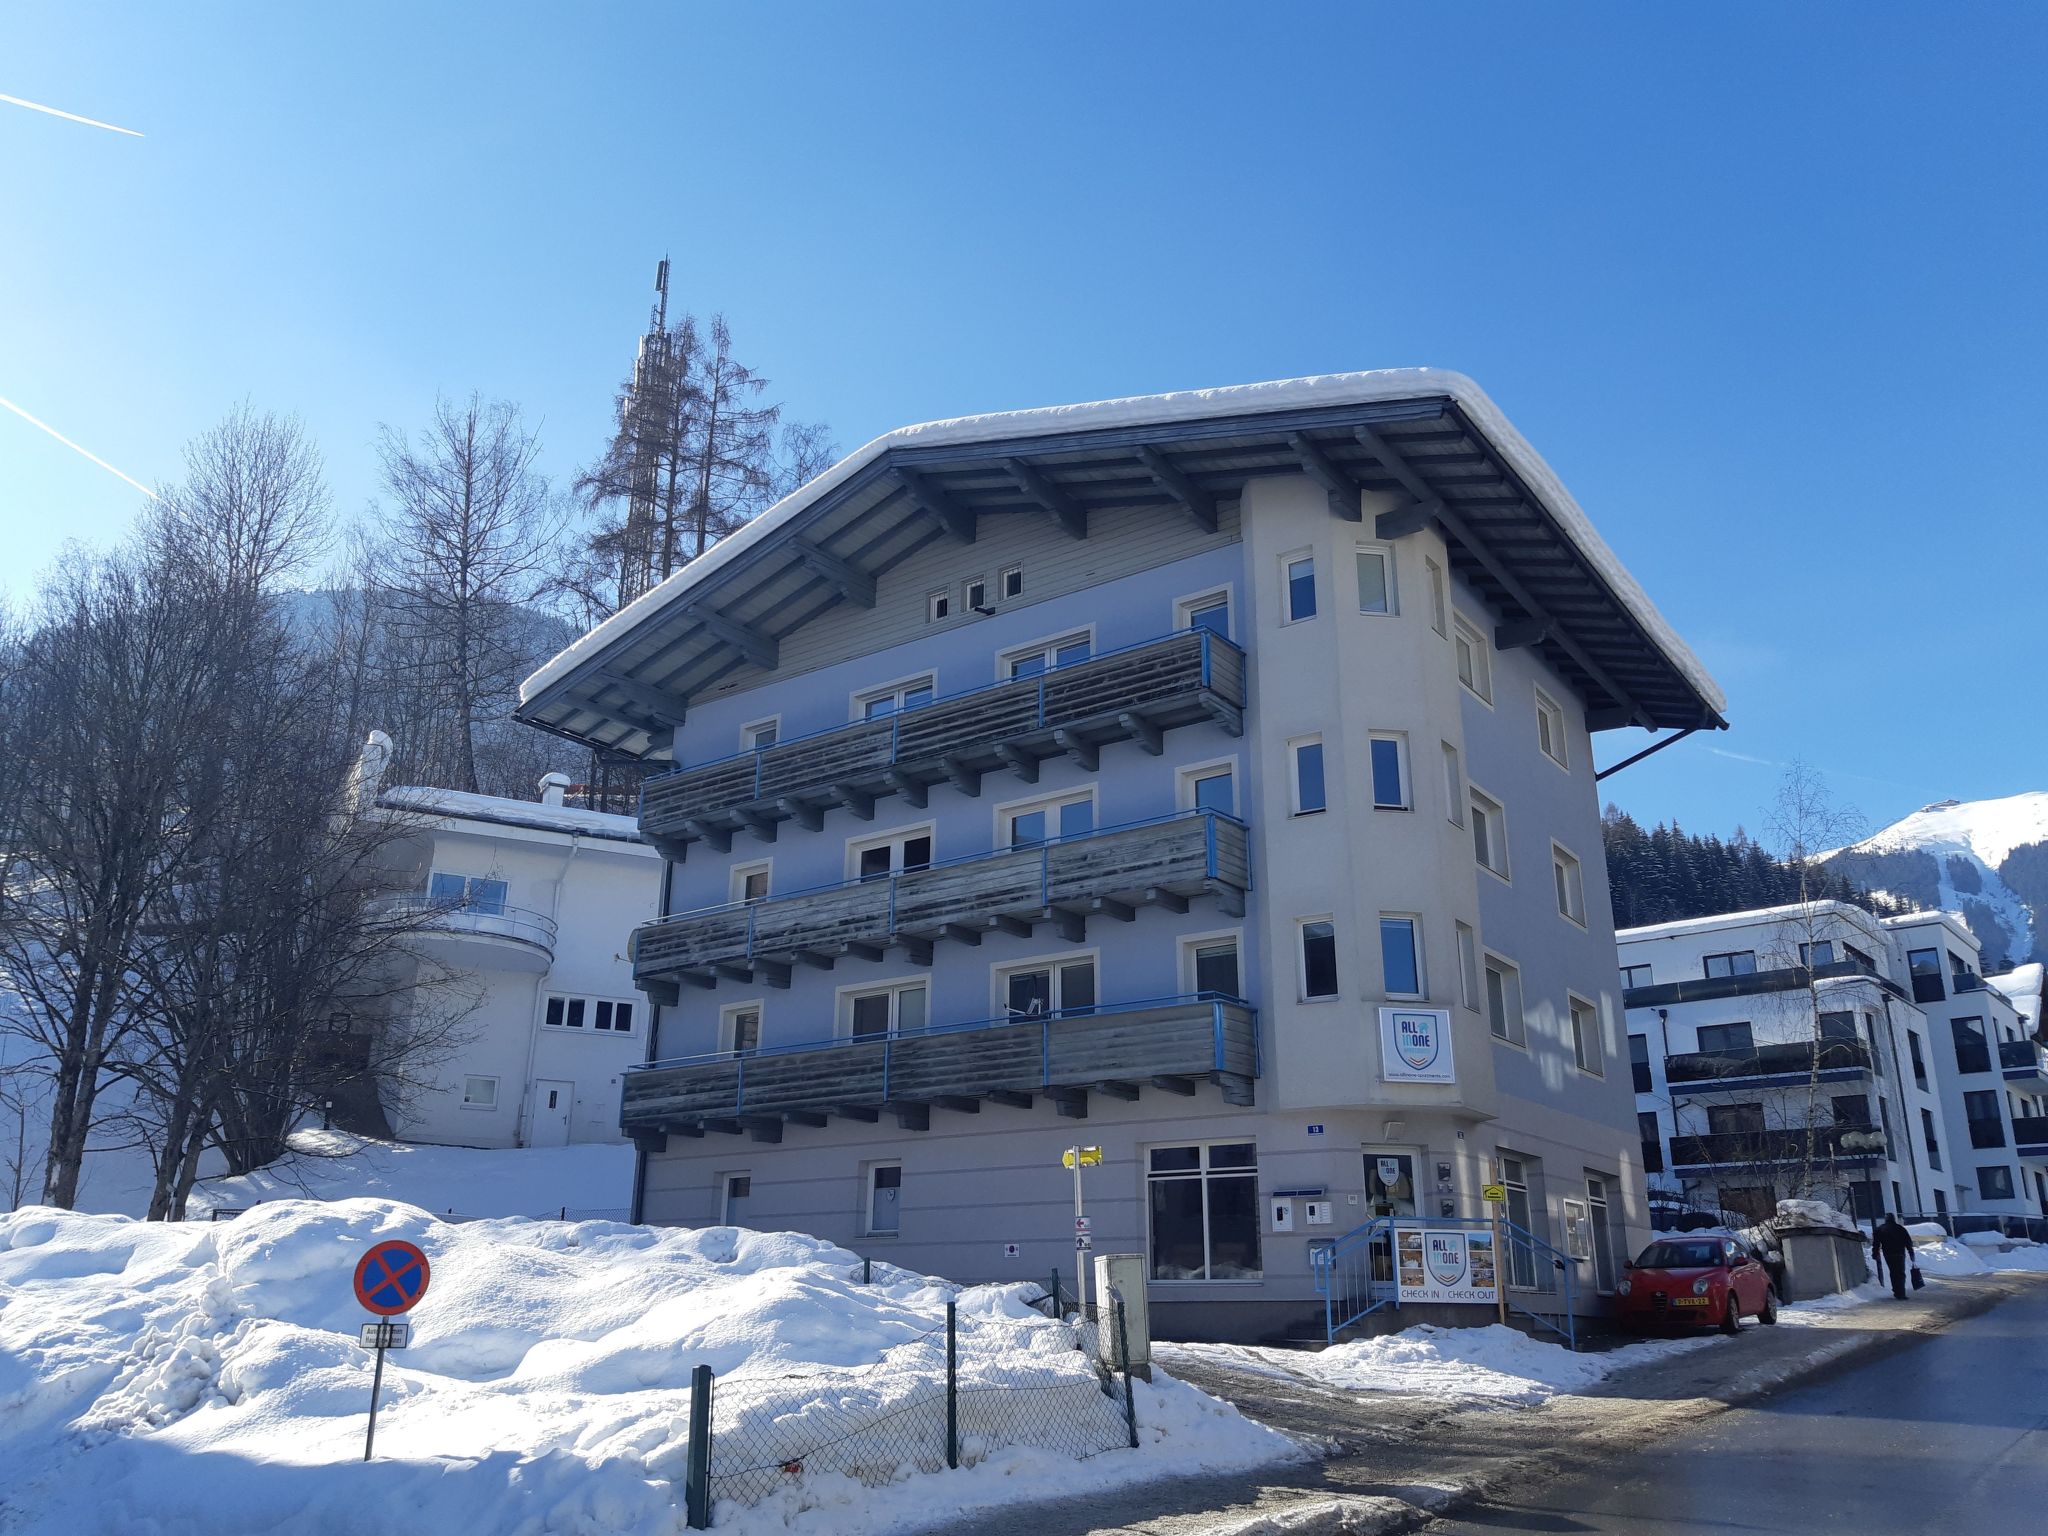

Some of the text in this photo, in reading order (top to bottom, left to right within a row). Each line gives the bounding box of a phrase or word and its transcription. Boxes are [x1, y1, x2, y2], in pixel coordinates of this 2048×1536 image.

[1401, 1021, 1418, 1034] ALL
[1432, 1240, 1448, 1252] ALL
[1401, 1290, 1429, 1298] CHECK
[1448, 1290, 1475, 1299] CHECK
[1477, 1290, 1495, 1300] OUT
